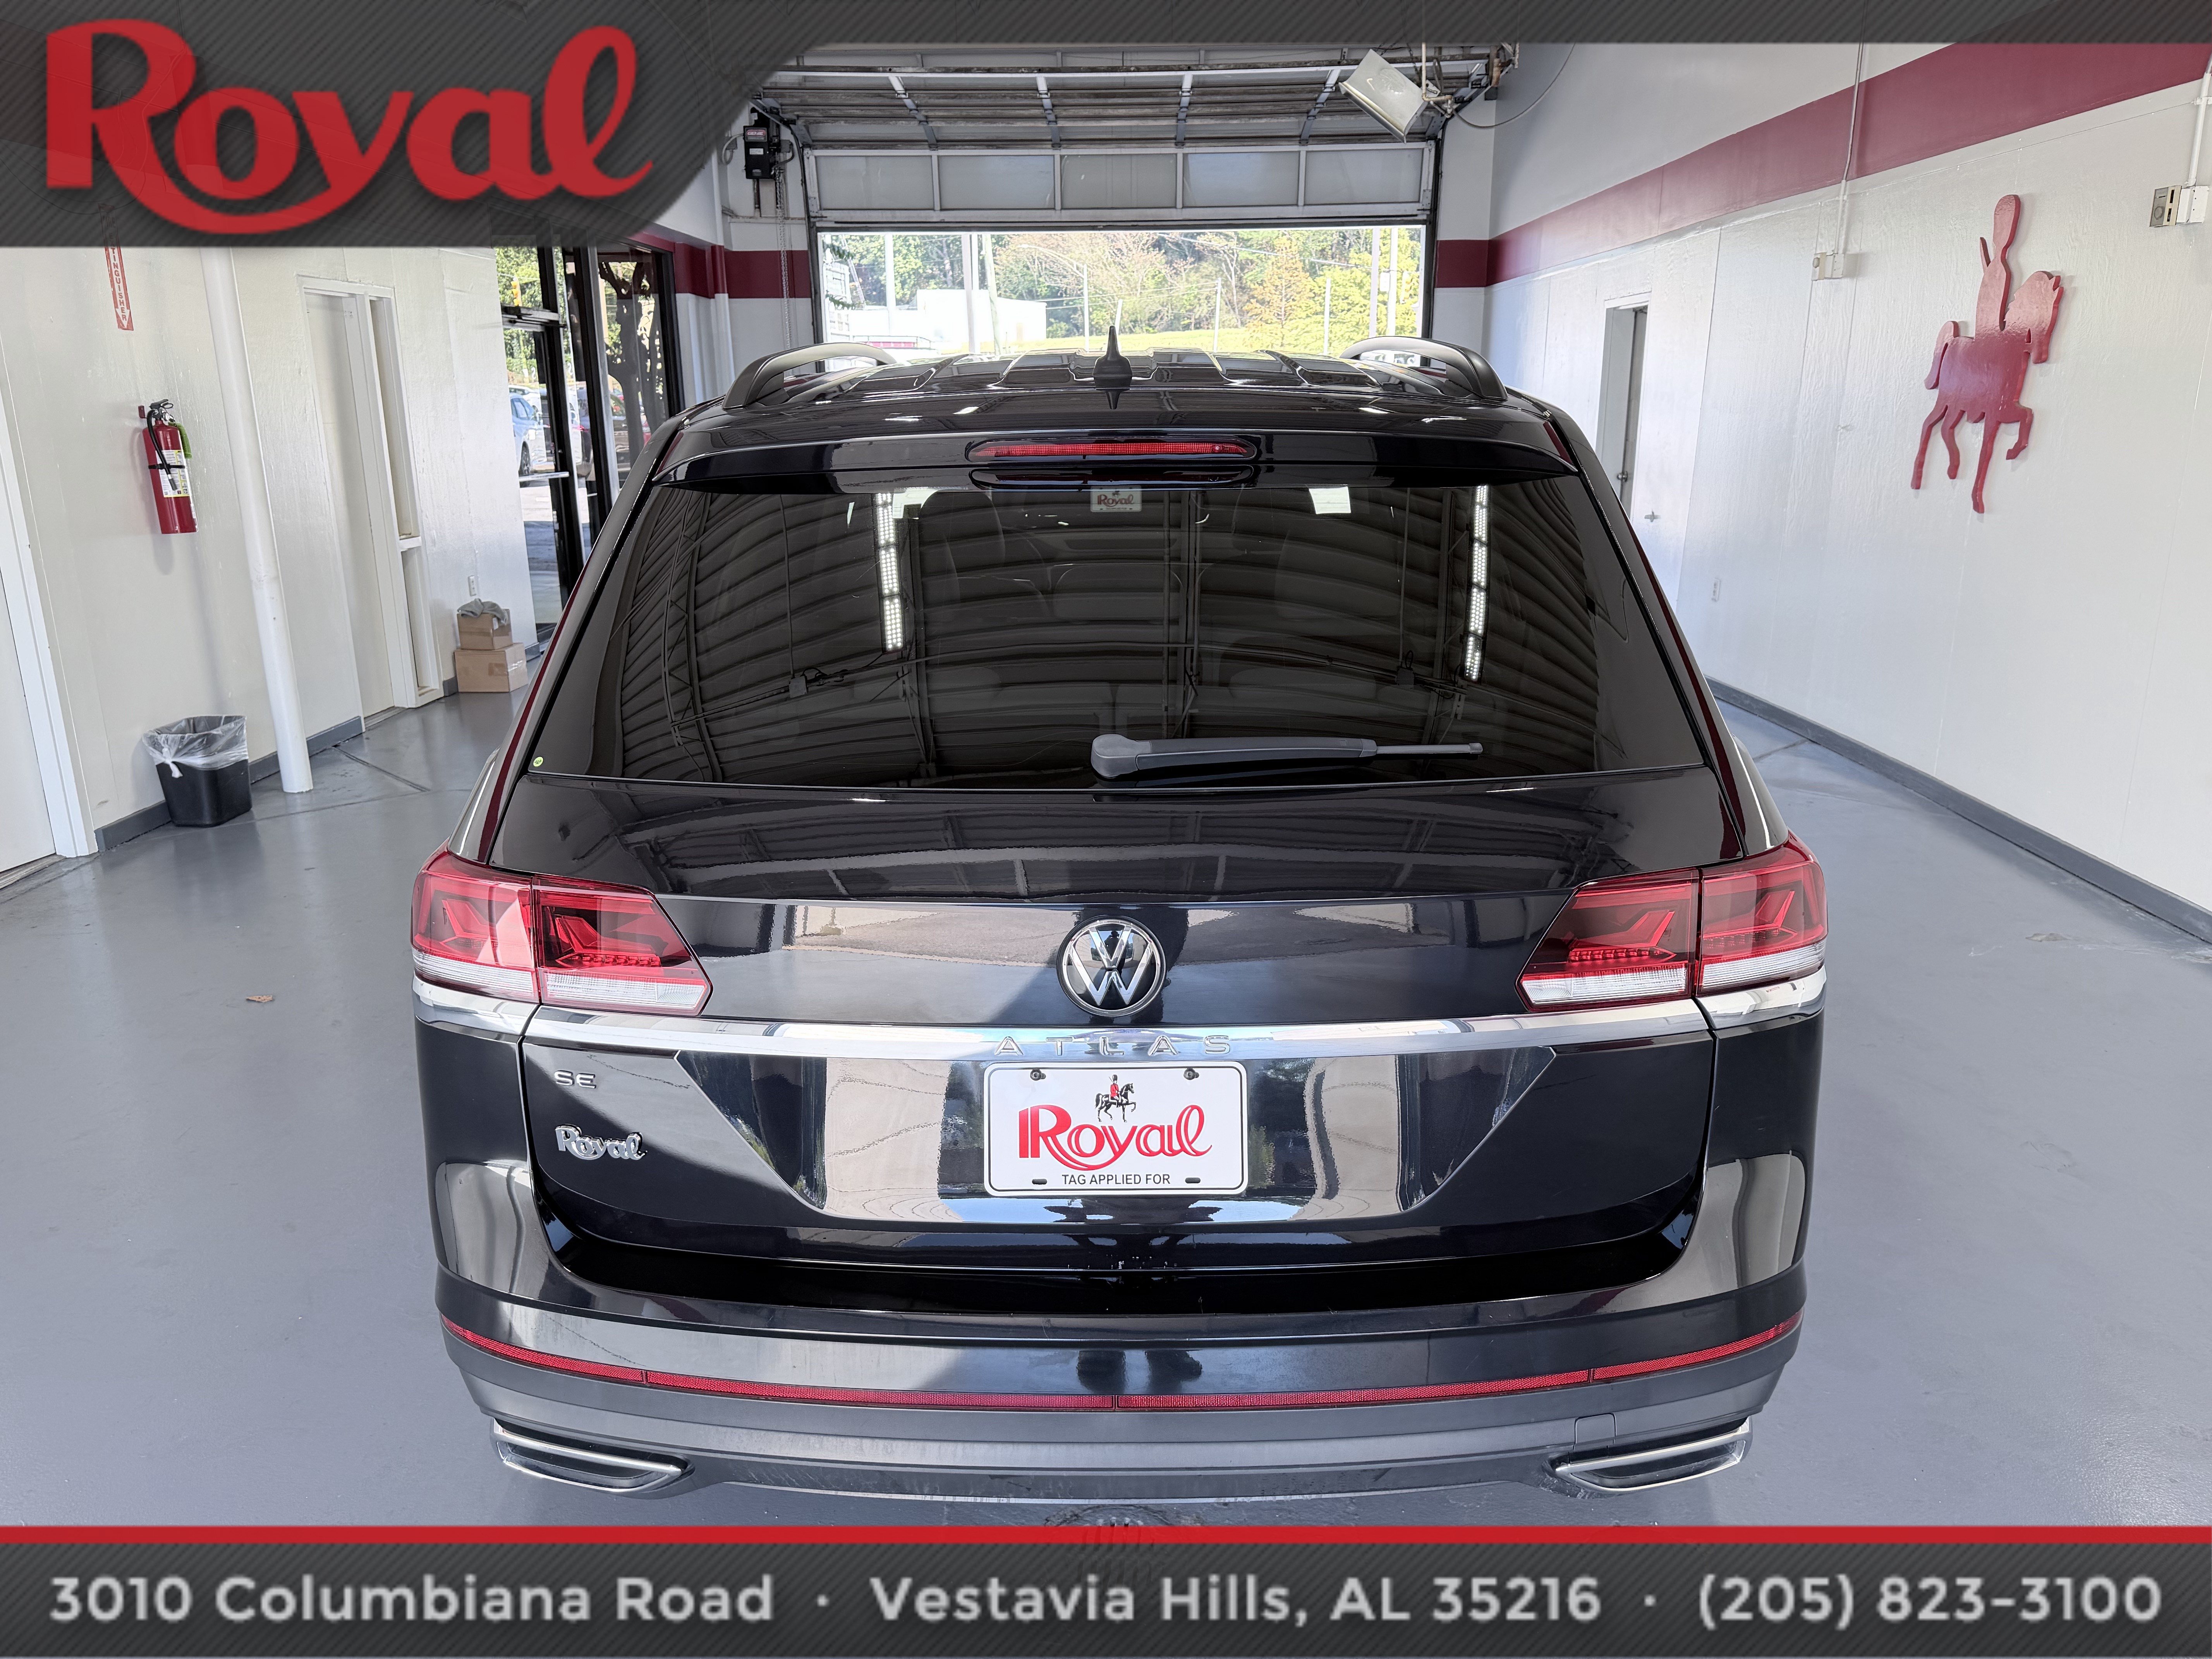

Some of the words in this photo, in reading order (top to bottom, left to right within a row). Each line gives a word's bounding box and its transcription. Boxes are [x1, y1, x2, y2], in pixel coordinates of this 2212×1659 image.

[1097, 494, 1135, 507] Royal
[994, 1035, 1231, 1056] ATLAS
[554, 1070, 597, 1089] SE
[555, 1123, 648, 1160] Royal
[1018, 1104, 1212, 1171] Royal
[1062, 1174, 1086, 1185] TAG
[1089, 1174, 1141, 1185] APPLIED
[1146, 1174, 1171, 1185] FOR
